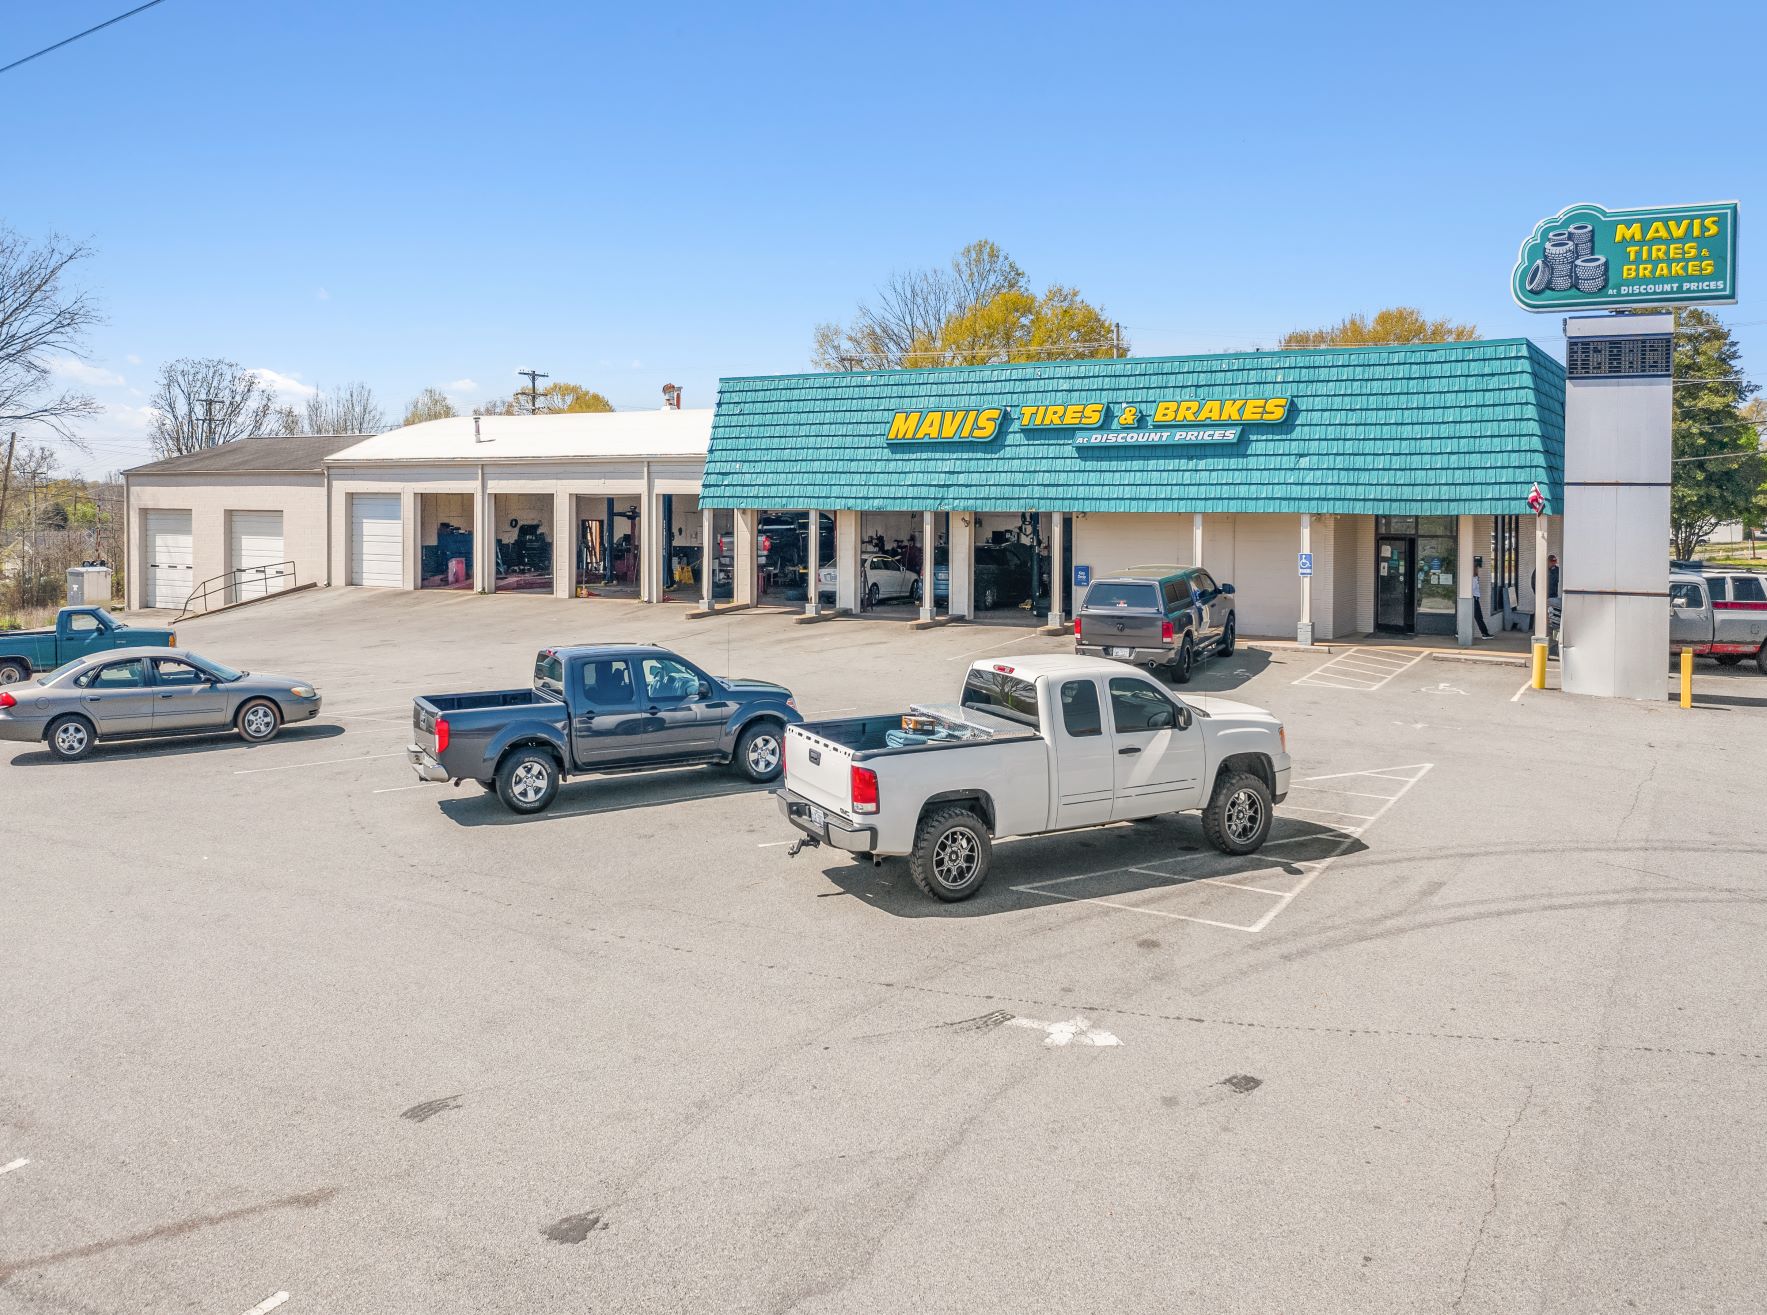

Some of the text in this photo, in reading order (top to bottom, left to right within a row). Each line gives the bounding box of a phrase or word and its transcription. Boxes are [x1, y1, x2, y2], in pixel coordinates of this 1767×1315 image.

[1614, 216, 1719, 243] MAVIS
[1626, 243, 1710, 261] TIRES &
[1622, 260, 1715, 279] BRAKES
[1620, 284, 1679, 294] DISCOUNT
[1682, 281, 1724, 291] PRICES
[887, 398, 1289, 440] MAVIS TIRES & BRAKES
[1090, 432, 1171, 443] DISCOUNT
[1174, 430, 1236, 441] PRICES
